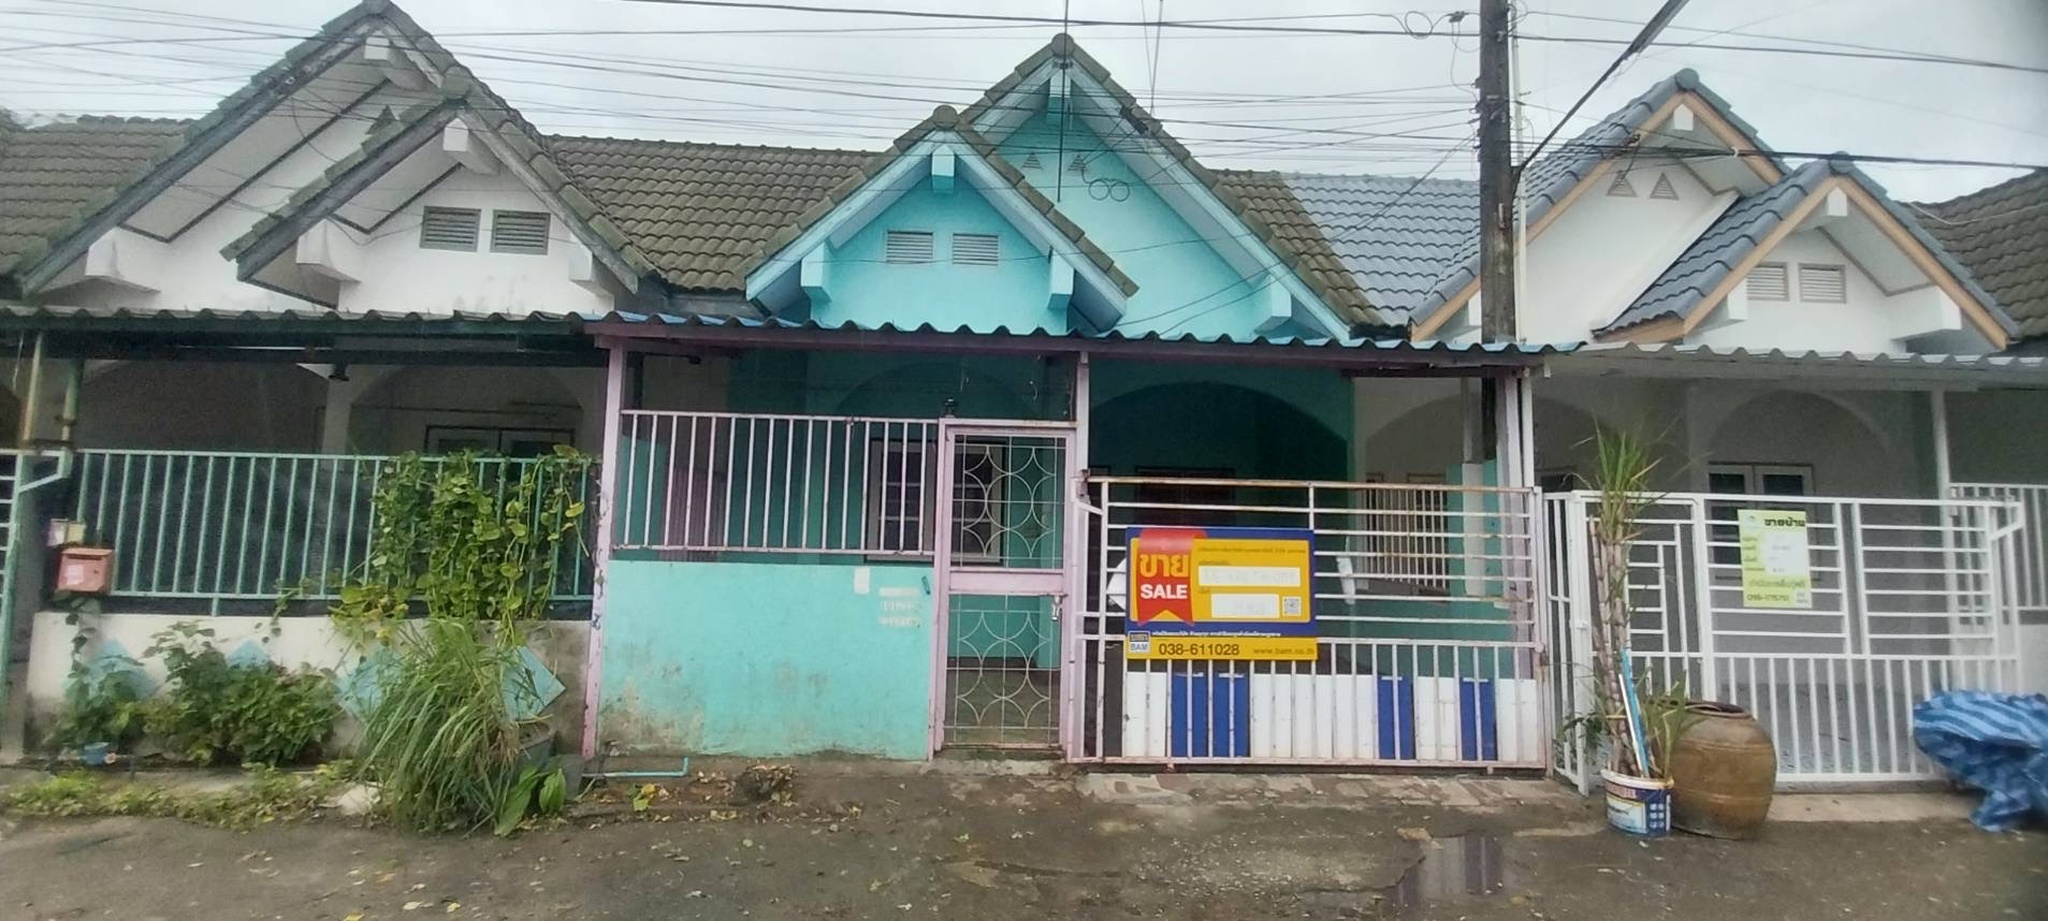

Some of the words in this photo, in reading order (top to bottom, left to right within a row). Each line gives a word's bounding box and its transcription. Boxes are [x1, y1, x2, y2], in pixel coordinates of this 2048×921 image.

[1139, 554, 1190, 578] ขาย
[1140, 584, 1188, 600] SALE
[1130, 643, 1148, 652] BAM
[1158, 643, 1240, 656] 038-611028
